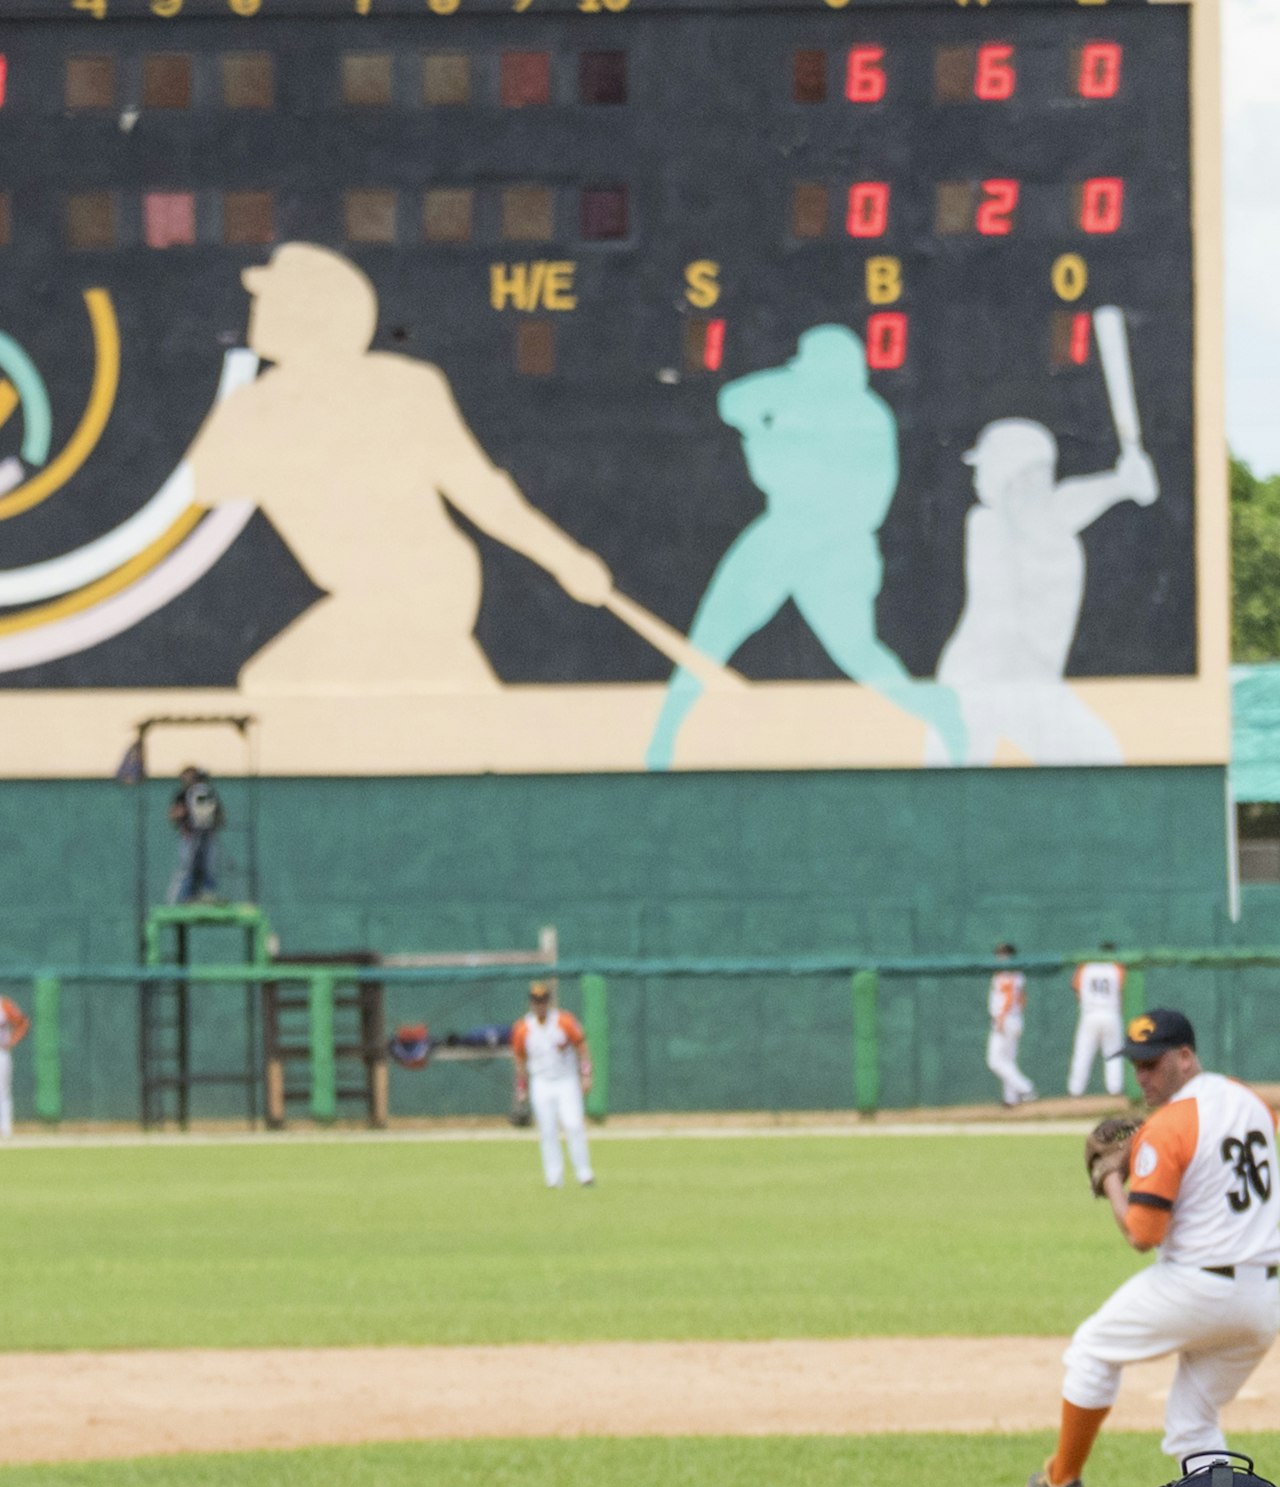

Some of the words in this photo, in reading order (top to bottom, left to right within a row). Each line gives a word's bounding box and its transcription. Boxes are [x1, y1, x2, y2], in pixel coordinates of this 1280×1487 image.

[844, 43, 888, 103] 6
[974, 42, 1016, 101] 6
[1078, 42, 1122, 99] 0
[845, 181, 890, 239] 0
[975, 178, 1019, 236] 2
[1080, 176, 1124, 234] 0
[489, 260, 578, 312] H/E
[685, 259, 720, 308] S
[865, 255, 903, 305] B
[703, 318, 726, 371] 1
[866, 311, 908, 370] 0
[1070, 312, 1091, 364] 1
[1221, 1130, 1272, 1214] 36
